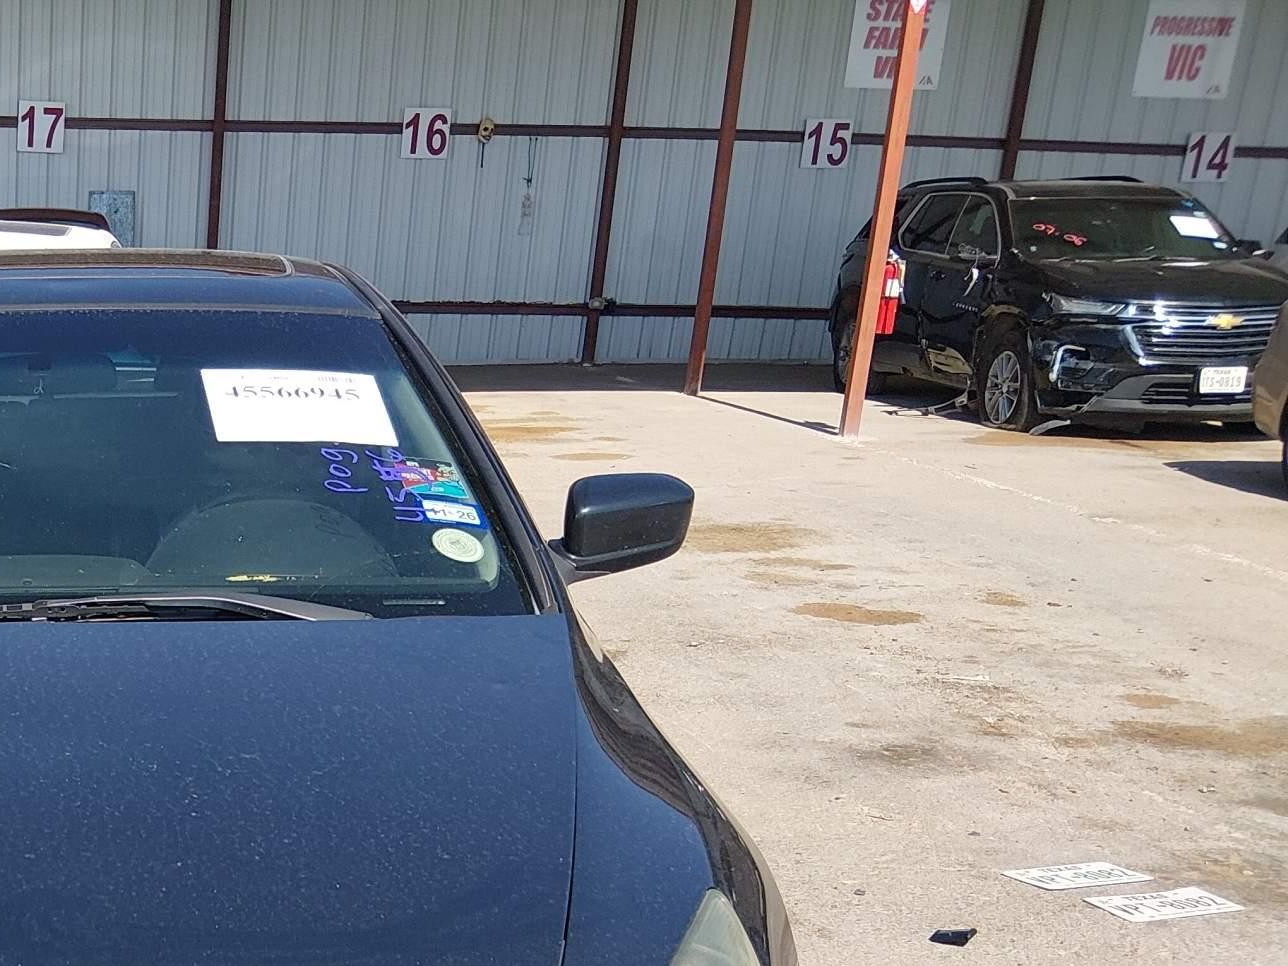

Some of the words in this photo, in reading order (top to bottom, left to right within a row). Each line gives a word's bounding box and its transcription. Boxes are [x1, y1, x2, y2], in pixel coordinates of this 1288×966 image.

[1150, 15, 1237, 37] PROGRESSIVE
[873, 54, 898, 80] VI
[1164, 43, 1207, 82] VIC
[20, 105, 65, 149] 17
[404, 112, 449, 156] 16
[807, 121, 851, 166] 15
[1189, 134, 1231, 179] 14
[225, 385, 361, 401] 45566945
[1124, 893, 1170, 903] TEXAS
